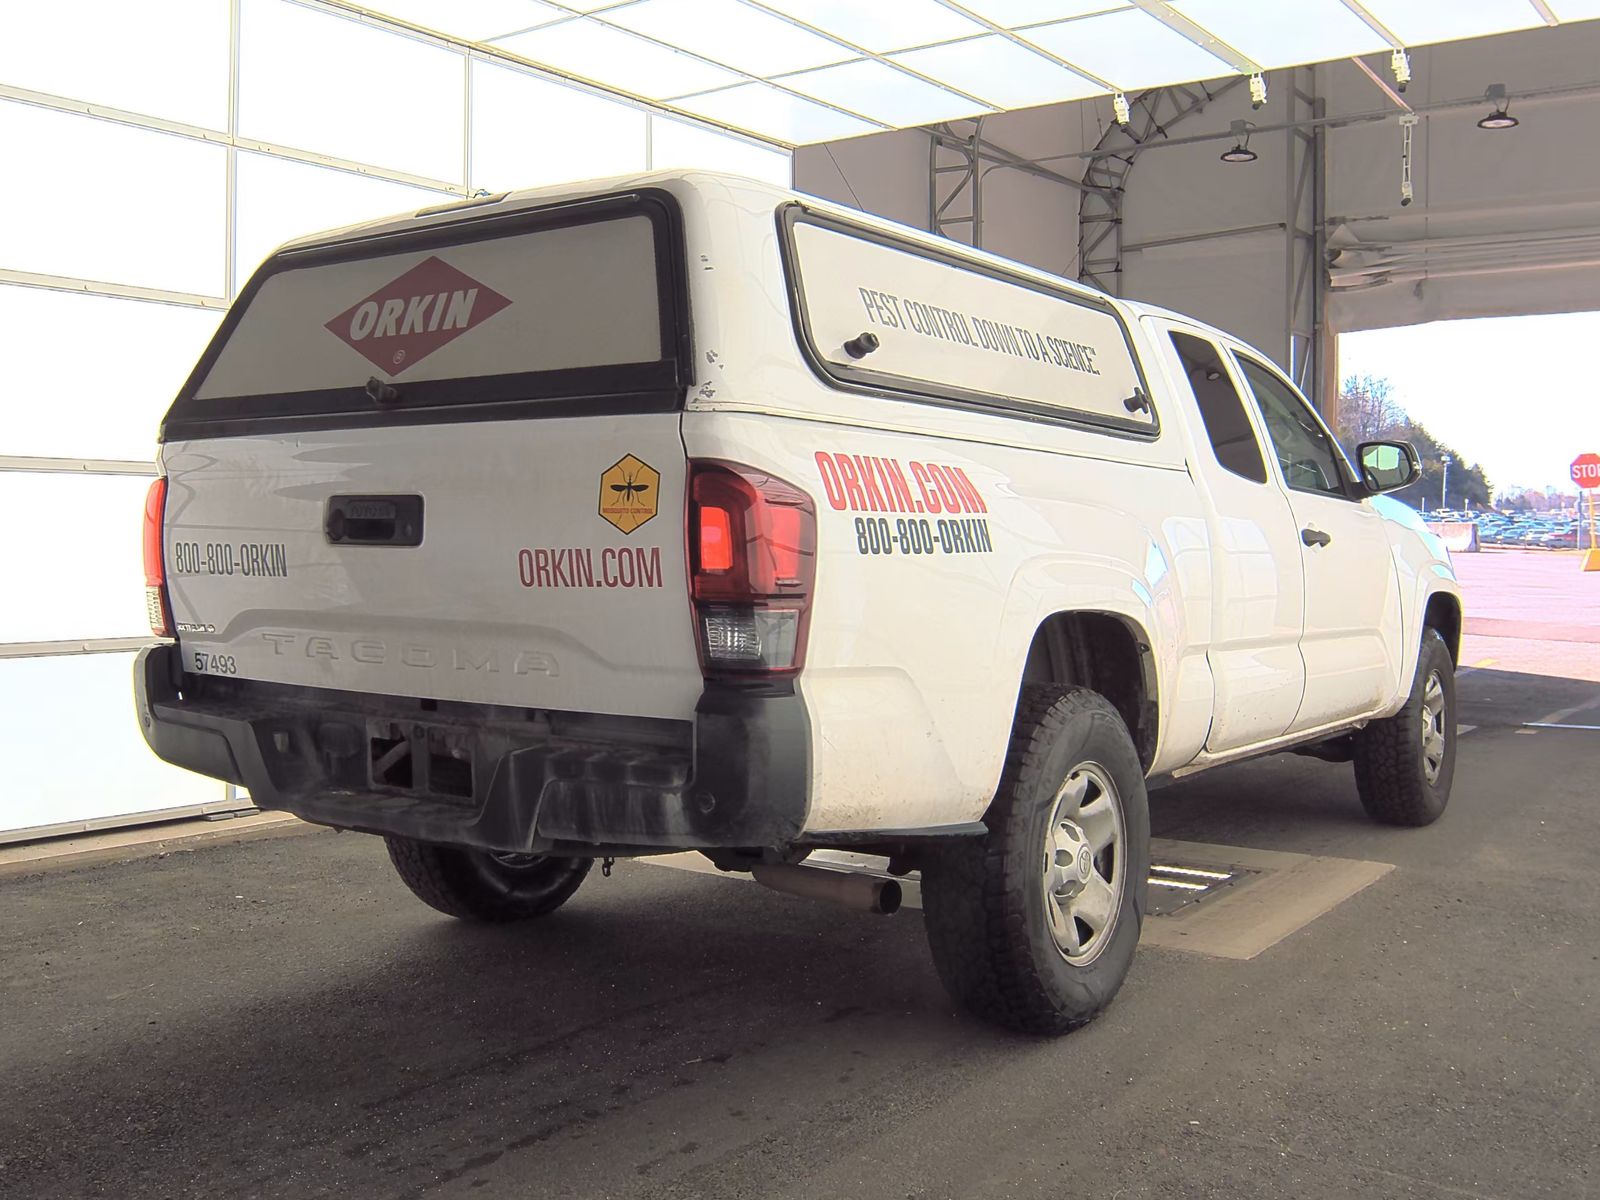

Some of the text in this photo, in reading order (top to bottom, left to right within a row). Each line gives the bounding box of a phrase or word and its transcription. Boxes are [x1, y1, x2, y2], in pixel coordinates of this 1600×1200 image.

[350, 288, 478, 341] ORKIN
[858, 287, 907, 330] PEST
[903, 299, 979, 348] CONTROL
[971, 316, 1024, 357] DOWN
[1015, 327, 1040, 361] TO
[1036, 332, 1053, 364] A
[815, 451, 988, 514] ORKIN.COM
[855, 517, 993, 555] 800-800-ORKIN
[175, 542, 288, 577] 800-800-ORKIN
[518, 547, 663, 588] ORKIN.COM
[194, 652, 237, 675] 57493
[261, 632, 560, 678] TACOMA
